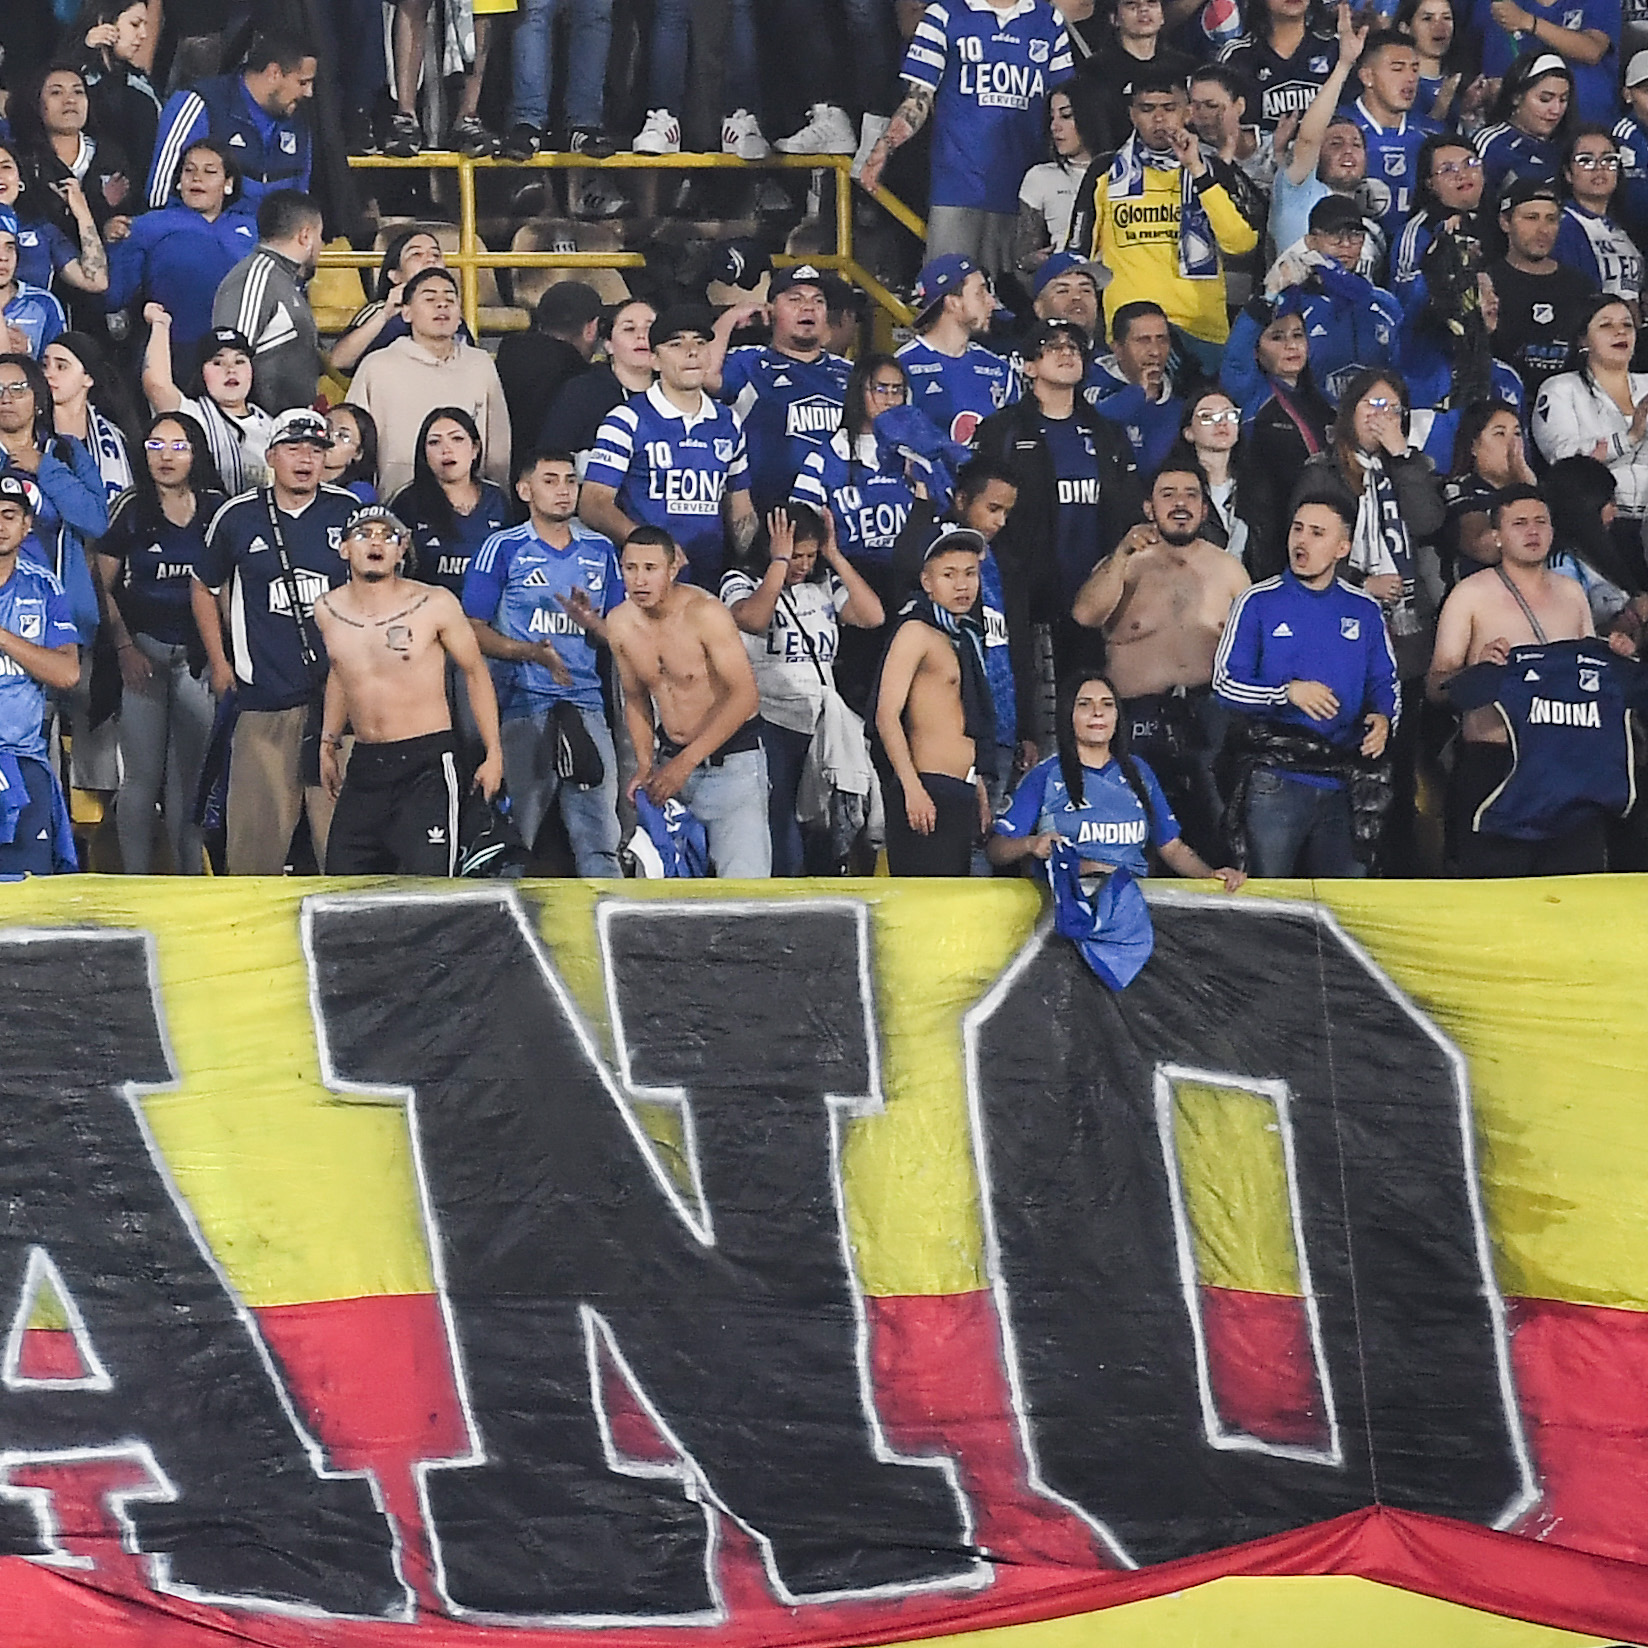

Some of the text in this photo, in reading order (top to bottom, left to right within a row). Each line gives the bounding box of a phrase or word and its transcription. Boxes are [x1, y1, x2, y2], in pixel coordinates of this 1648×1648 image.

[957, 36, 982, 63] 10
[960, 62, 1045, 98] LEONA
[981, 97, 1029, 110] CERVEZA
[644, 442, 672, 470] 10
[667, 502, 718, 516] CERVEZA
[832, 487, 862, 514] 10
[766, 626, 836, 658] LEON
[1079, 820, 1148, 845] ANDINA
